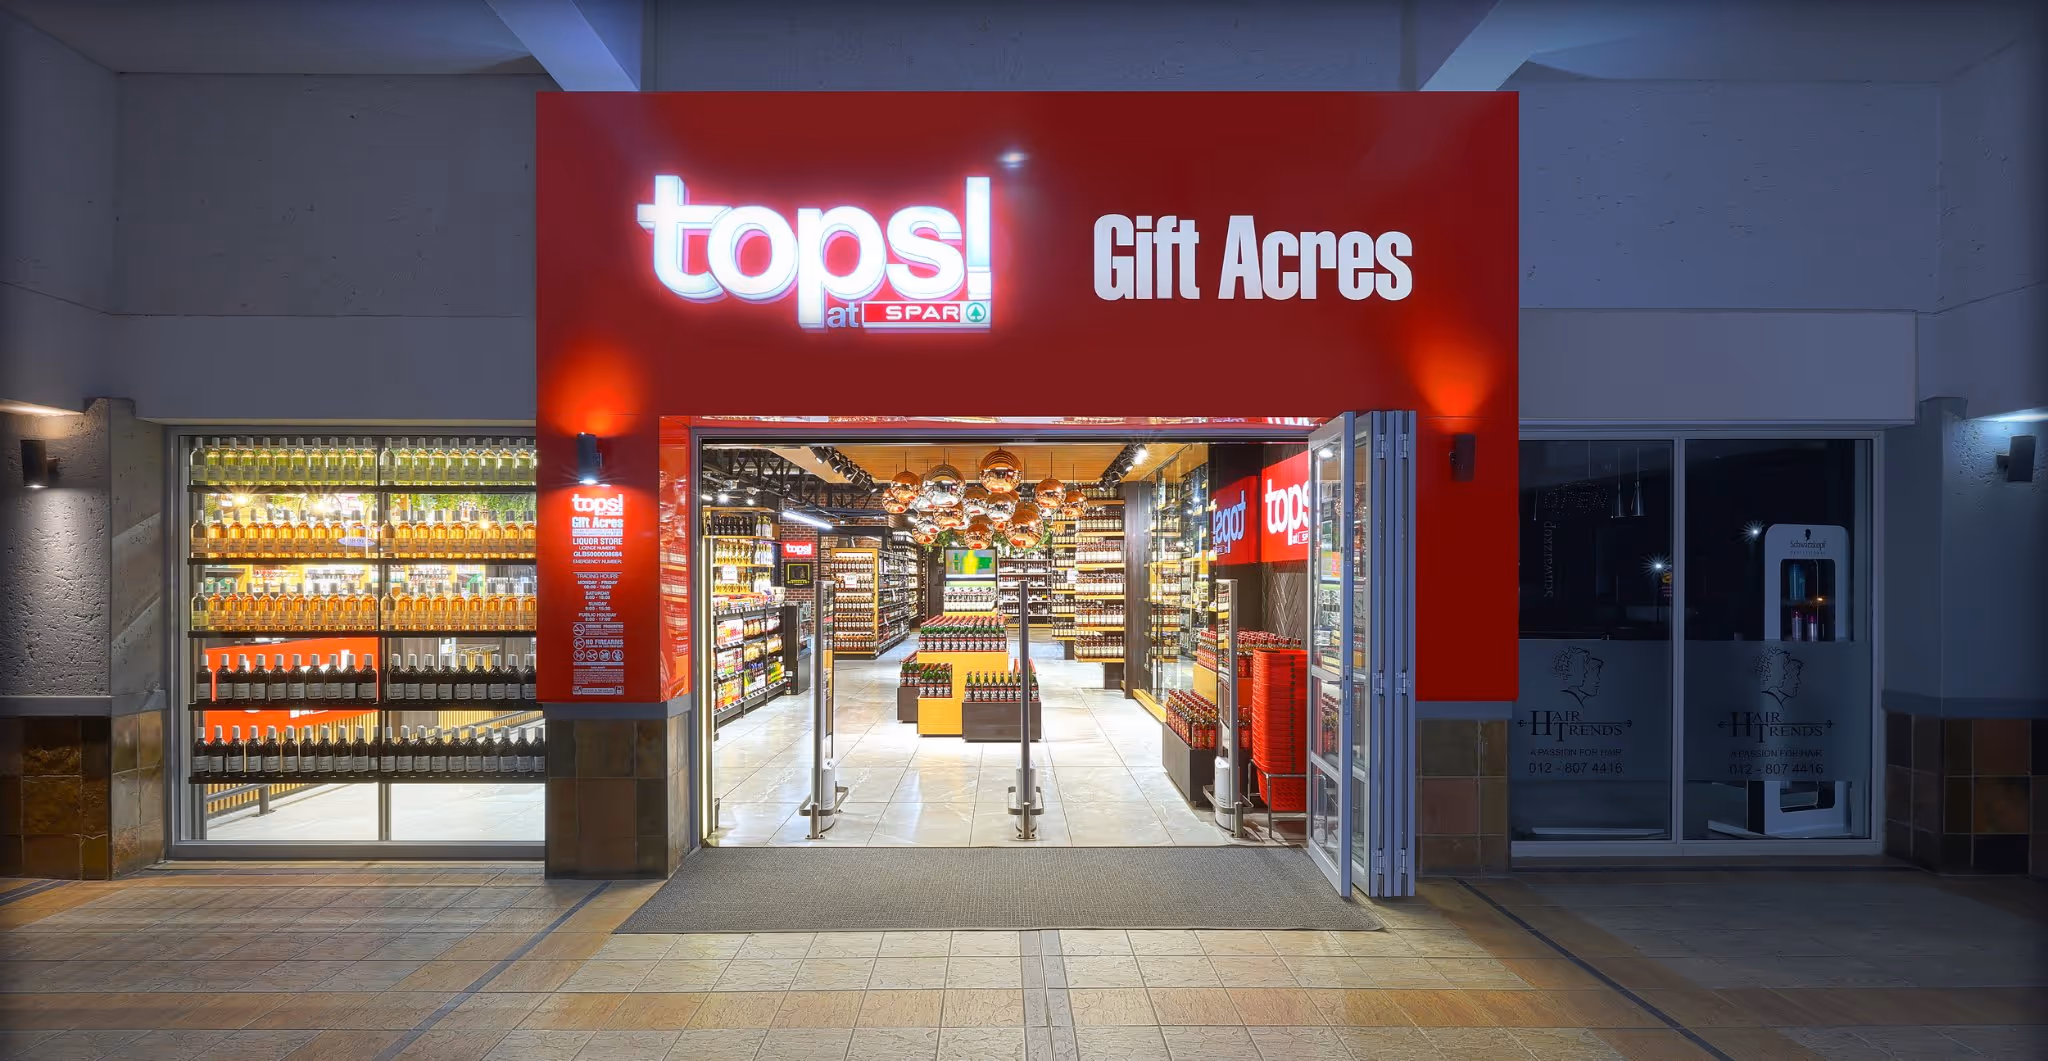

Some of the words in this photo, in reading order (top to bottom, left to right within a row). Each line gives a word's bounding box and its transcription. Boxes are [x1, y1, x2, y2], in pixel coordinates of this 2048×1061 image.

[637, 174, 992, 329] tops!
[1094, 214, 1200, 300] Gift
[1218, 215, 1412, 300] Acres
[827, 302, 859, 328] at
[886, 305, 959, 321] SPAR
[572, 494, 624, 516] tops!
[572, 516, 590, 528] Gift
[593, 516, 624, 528] Acres
[1530, 710, 1582, 736] HAIR
[1554, 722, 1623, 742] TRENDS
[1729, 712, 1782, 737] HAIR
[1754, 724, 1823, 743] TRENDS
[1529, 763, 1552, 773] 012
[1564, 763, 1587, 773] 807
[1592, 763, 1623, 773] 4416
[1729, 764, 1752, 774] 012
[1765, 764, 1788, 774] 807
